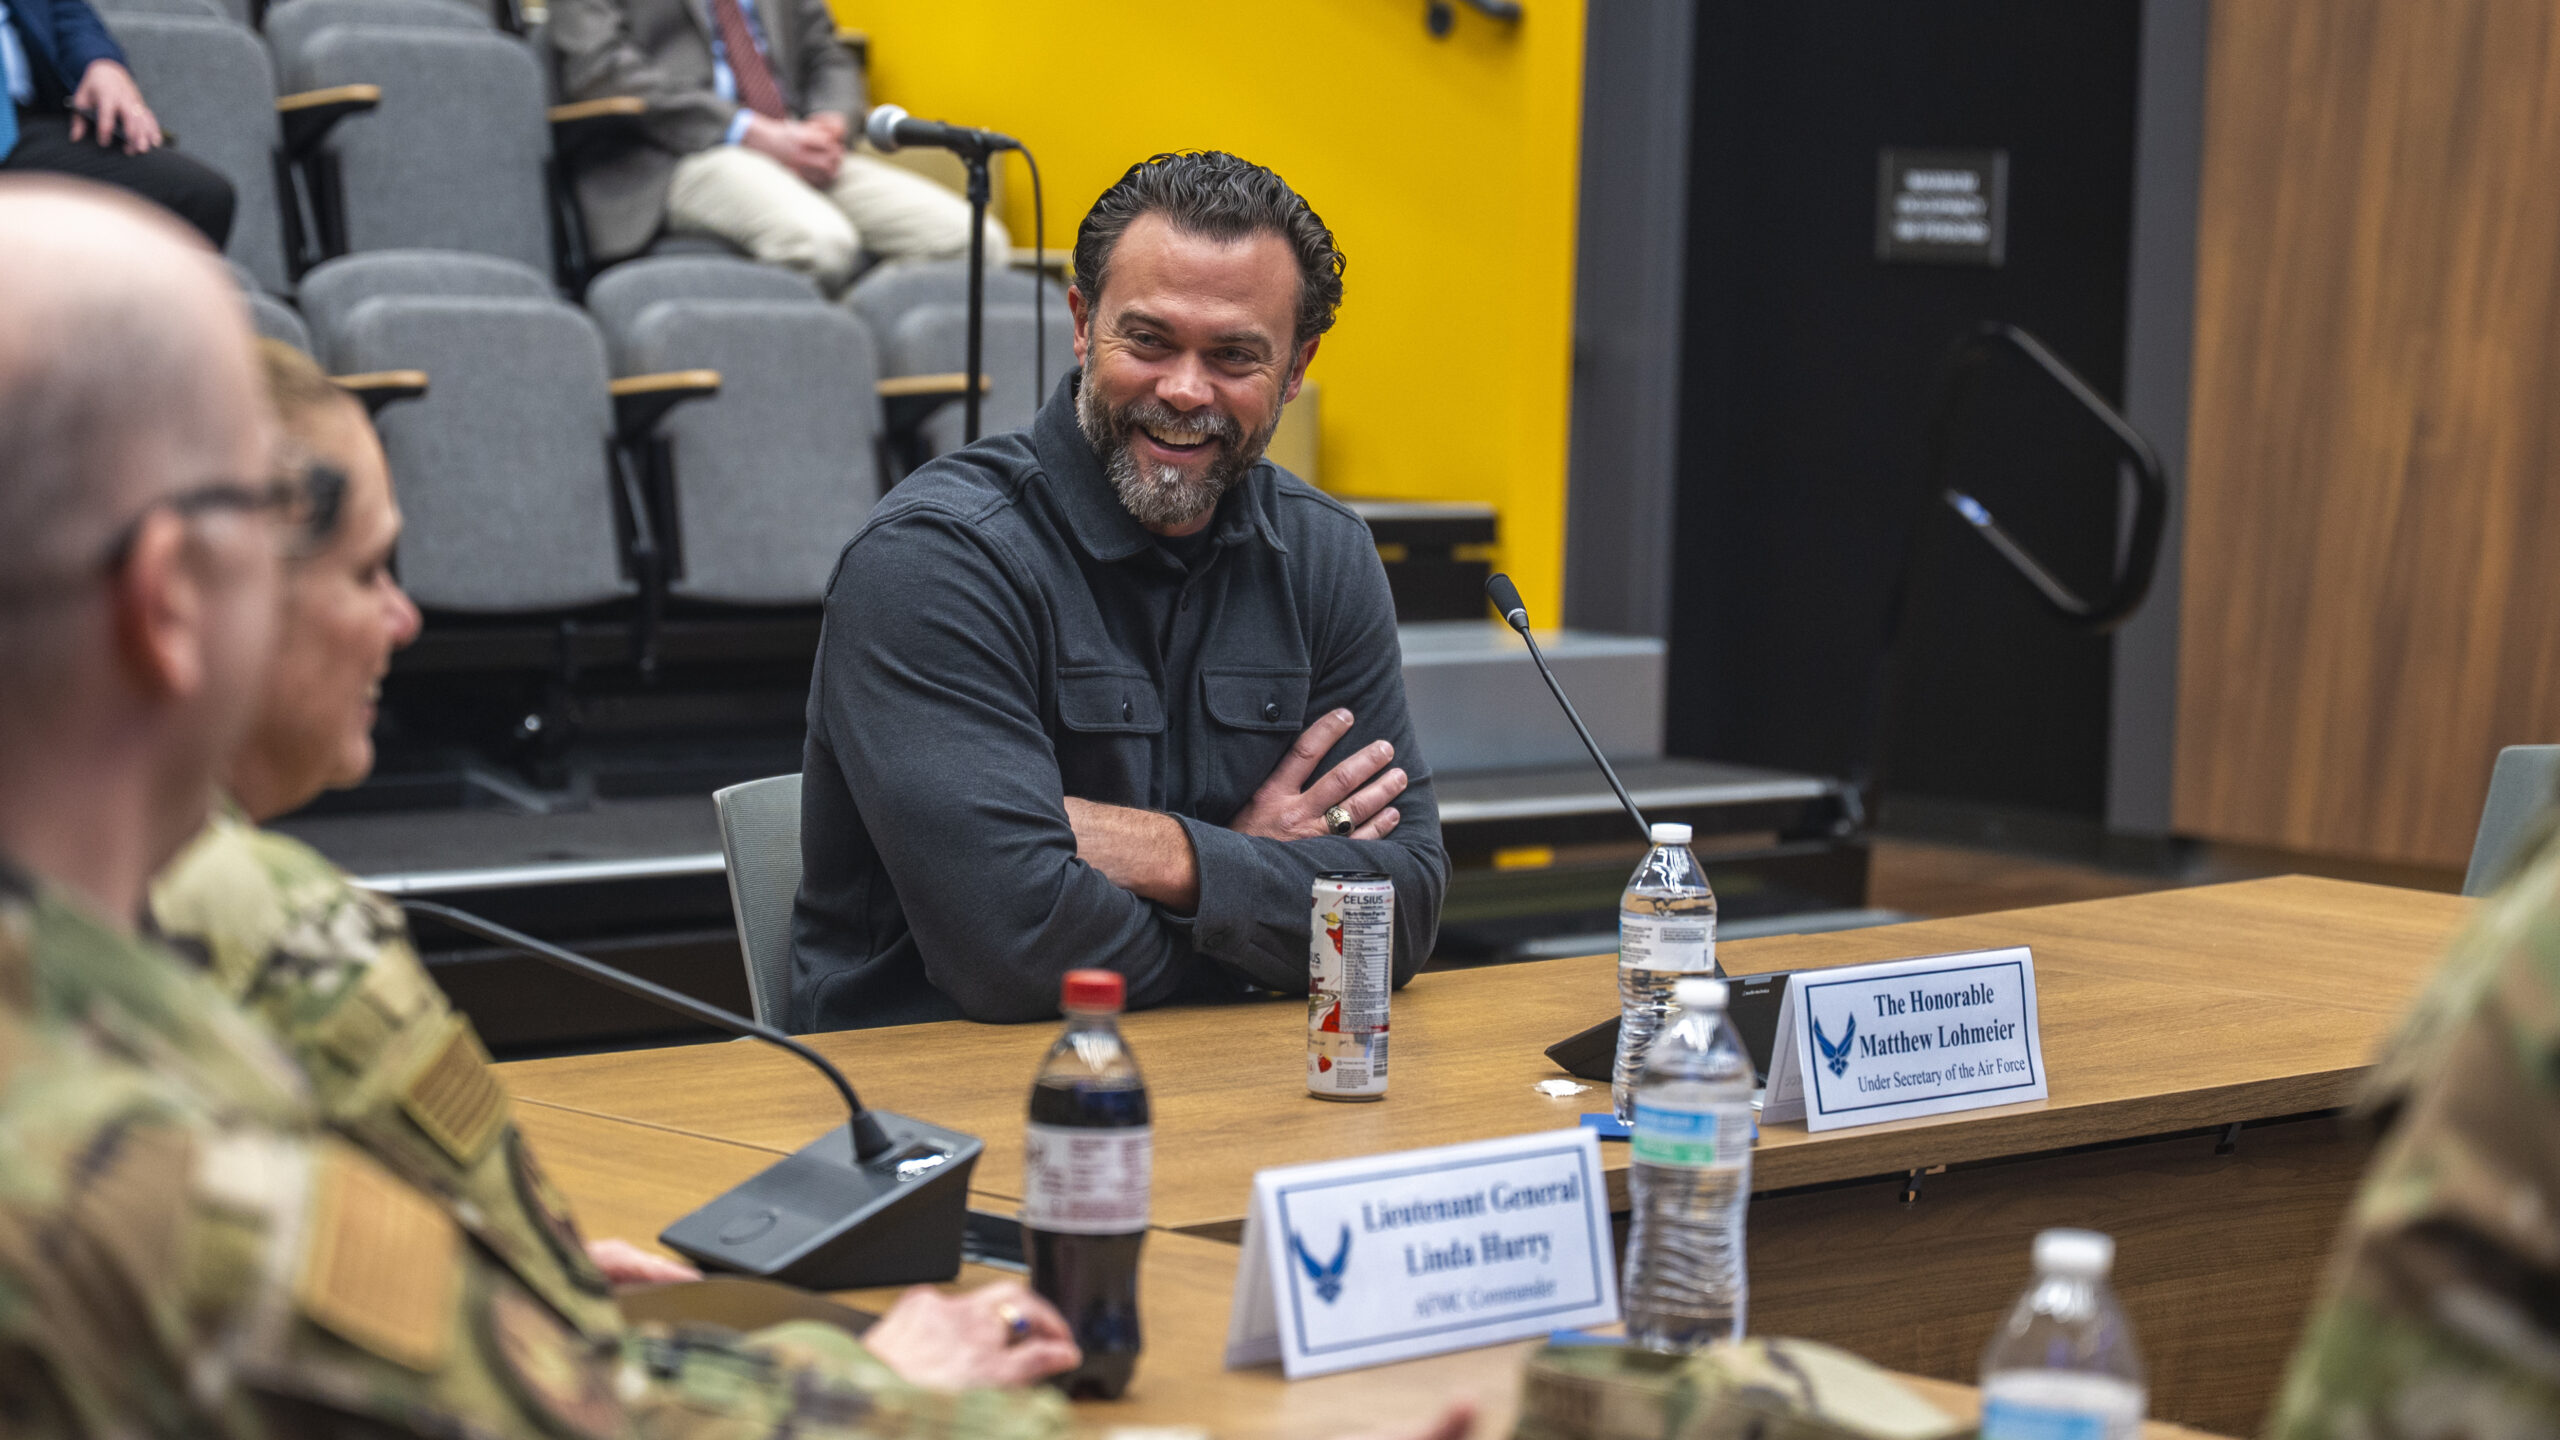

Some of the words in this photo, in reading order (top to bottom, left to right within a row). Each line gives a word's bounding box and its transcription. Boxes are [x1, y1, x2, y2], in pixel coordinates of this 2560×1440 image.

[1344, 895, 1383, 904] CELSIUS
[1874, 994, 1905, 1017] The
[1909, 983, 1995, 1013] Honorable
[1859, 1031, 1933, 1059] Matthew
[1938, 1018, 2016, 1049] Lohmeier
[1858, 1073, 1891, 1093] Under
[1893, 1070, 1942, 1088] Secretary
[1945, 1063, 1958, 1080] of
[1958, 1062, 1975, 1078] the
[1977, 1060, 1995, 1076] Air
[1996, 1057, 2026, 1074] Force
[1363, 1194, 1484, 1232] Lieutenant
[1490, 1173, 1579, 1212] General
[1405, 1240, 1475, 1276] Linda
